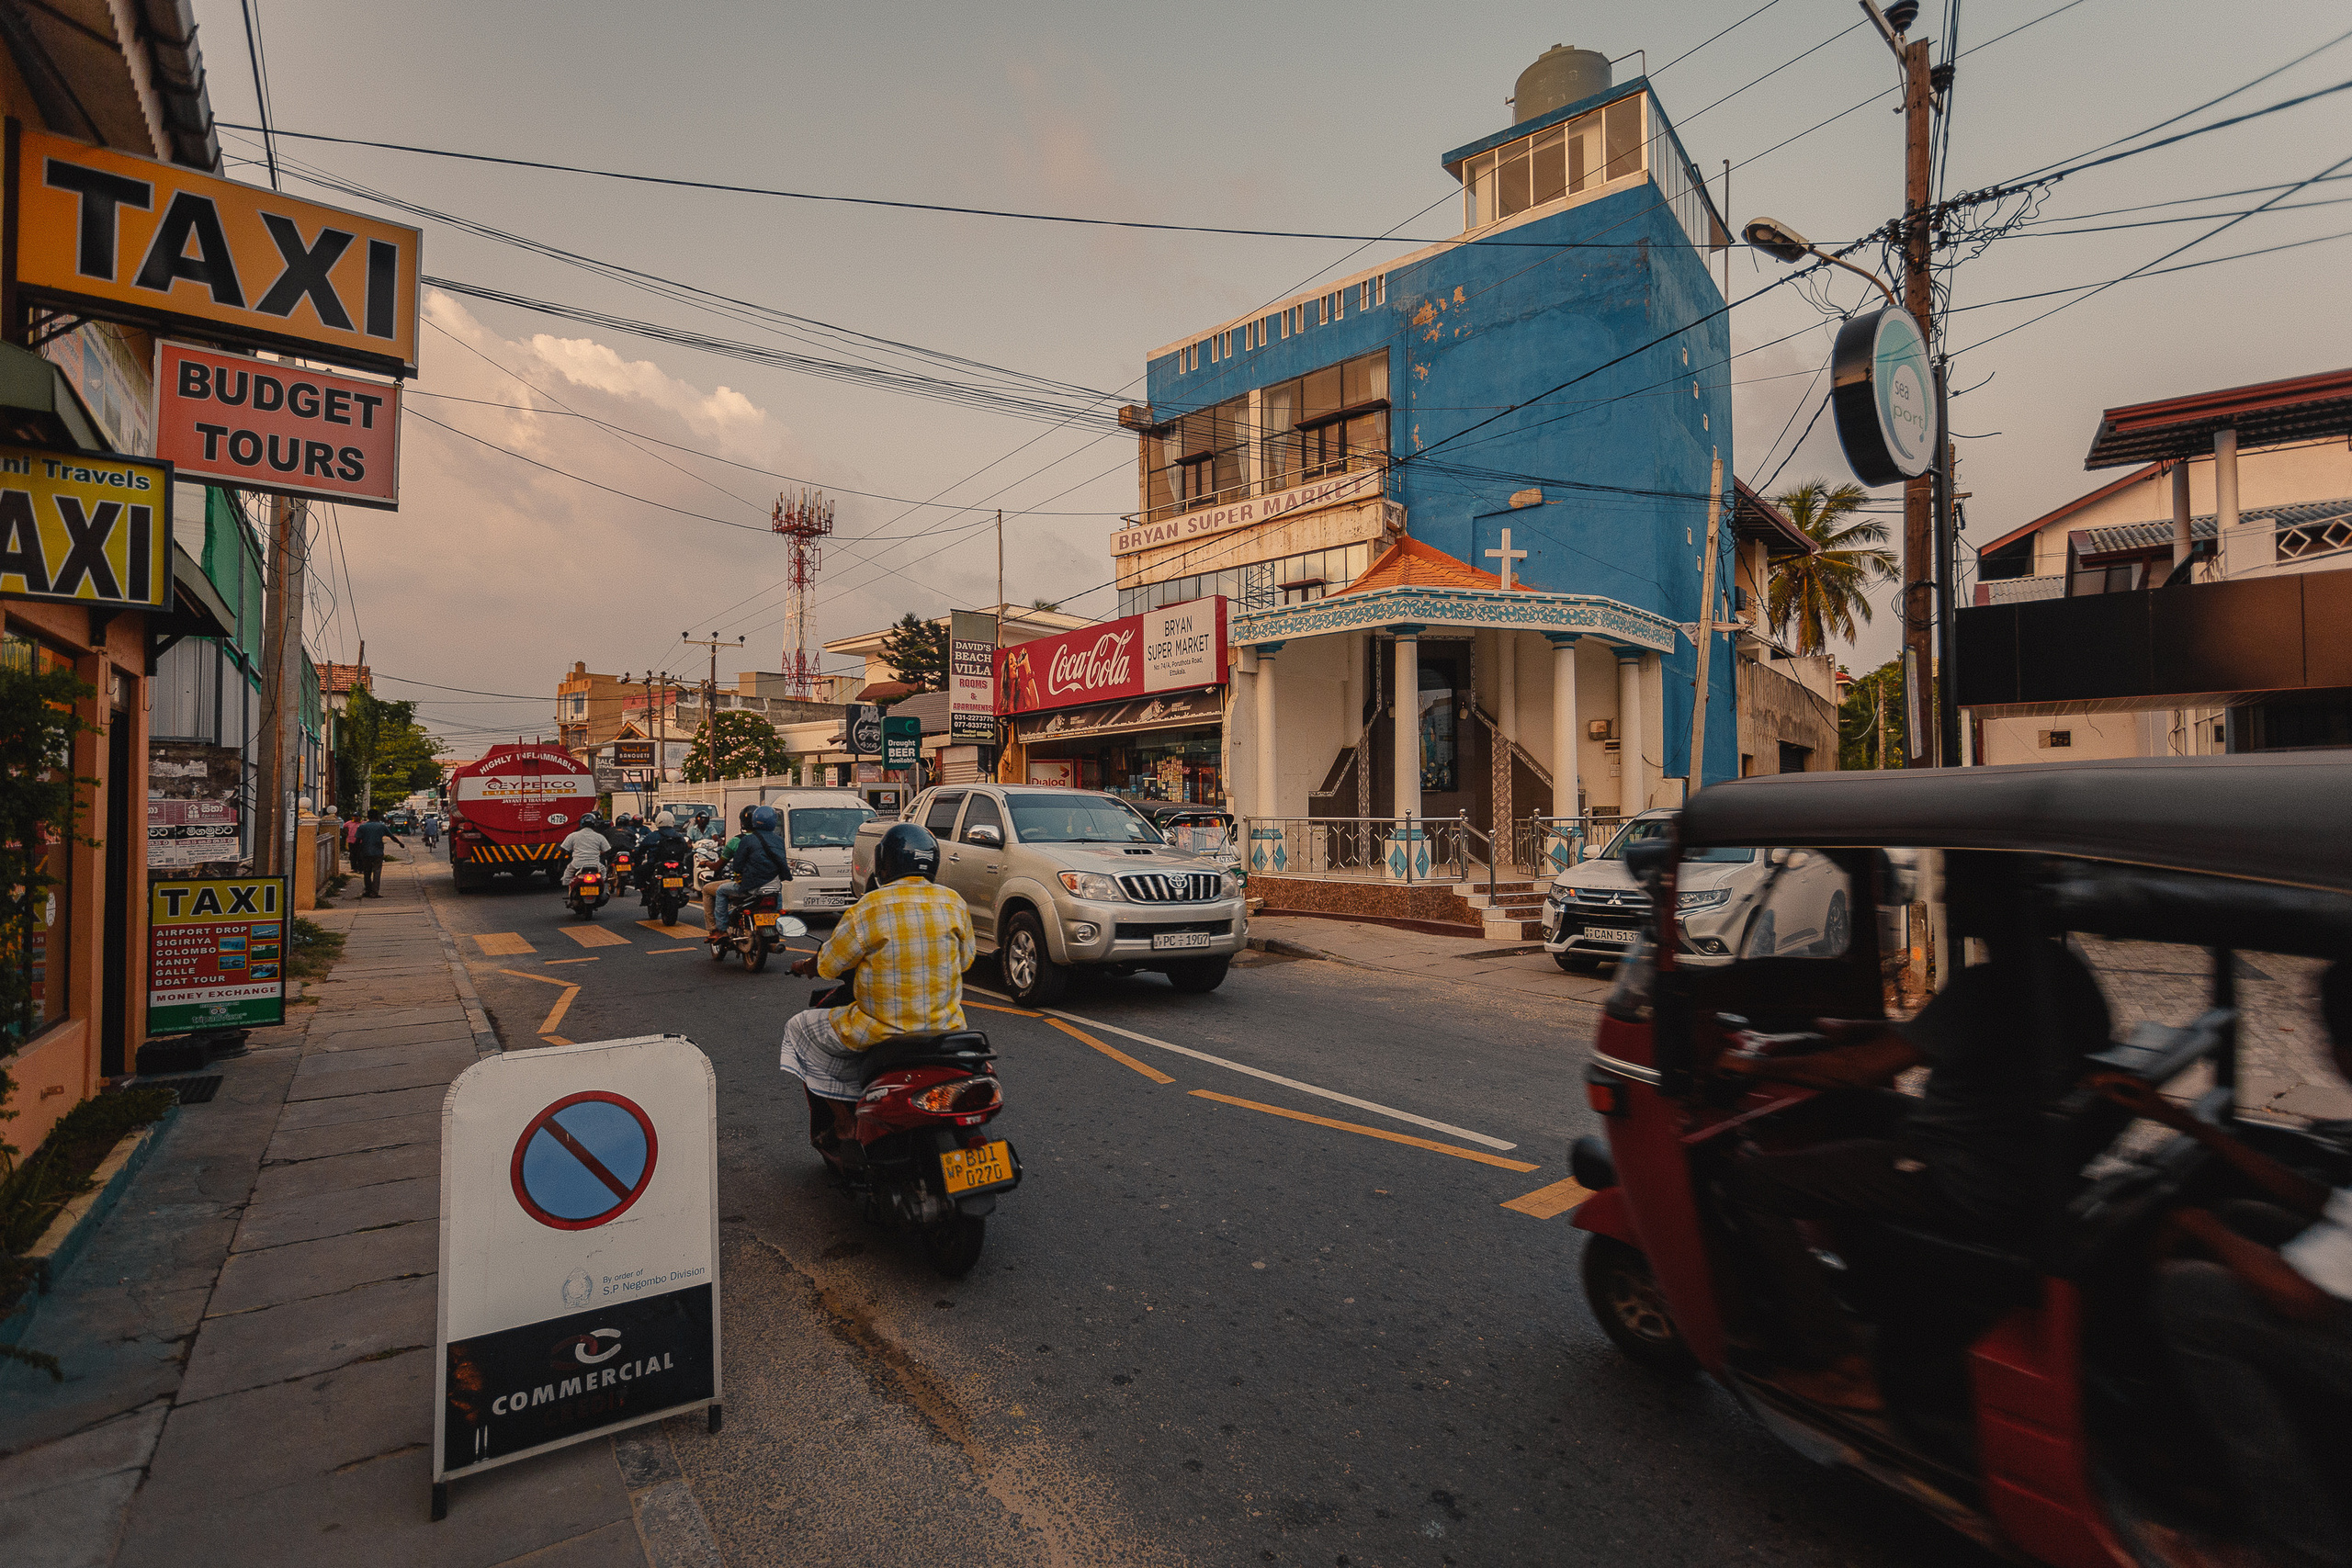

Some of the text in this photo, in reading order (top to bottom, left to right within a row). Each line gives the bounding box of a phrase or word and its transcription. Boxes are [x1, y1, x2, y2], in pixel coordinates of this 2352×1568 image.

[43, 156, 399, 341] TAXI
[177, 359, 383, 429] BUDGET
[1894, 379, 1909, 400] sea
[1893, 403, 1924, 430] port
[194, 422, 366, 482] TOURS
[41, 458, 151, 491] Travels
[1118, 478, 1363, 550] BRYAN SUPER MARKET
[1164, 615, 1193, 637] BRYAN
[955, 641, 991, 652] DAVID'S
[1148, 634, 1209, 661] SUPER MARKET
[955, 651, 992, 663] BEACH
[1047, 628, 1136, 695] Coca-Cola
[955, 663, 992, 676] VILLA
[959, 678, 988, 689] ROOMS
[953, 703, 993, 712] APARTMENTS
[888, 748, 916, 757] BEER
[479, 752, 578, 774] HIGHLY INFLAMMABLE
[158, 885, 277, 917] TAXI
[156, 926, 248, 937] AIRPORT DROP
[1594, 930, 1613, 940] CAN
[156, 938, 212, 947] SIGIRIYA
[1163, 935, 1176, 946] PC
[1186, 934, 1208, 945] 1907
[156, 947, 217, 956] COLOMBO
[155, 957, 198, 966] KANDY
[155, 967, 196, 976] GALLE
[155, 975, 226, 987] BOAT TOUR
[156, 986, 277, 1002] MONEY EXCHANGE
[945, 1163, 1002, 1186] WP 0270
[603, 1268, 644, 1284] By order of
[603, 1266, 706, 1296] S.P Negombo Division
[492, 1352, 674, 1416] COMMERCIAL
